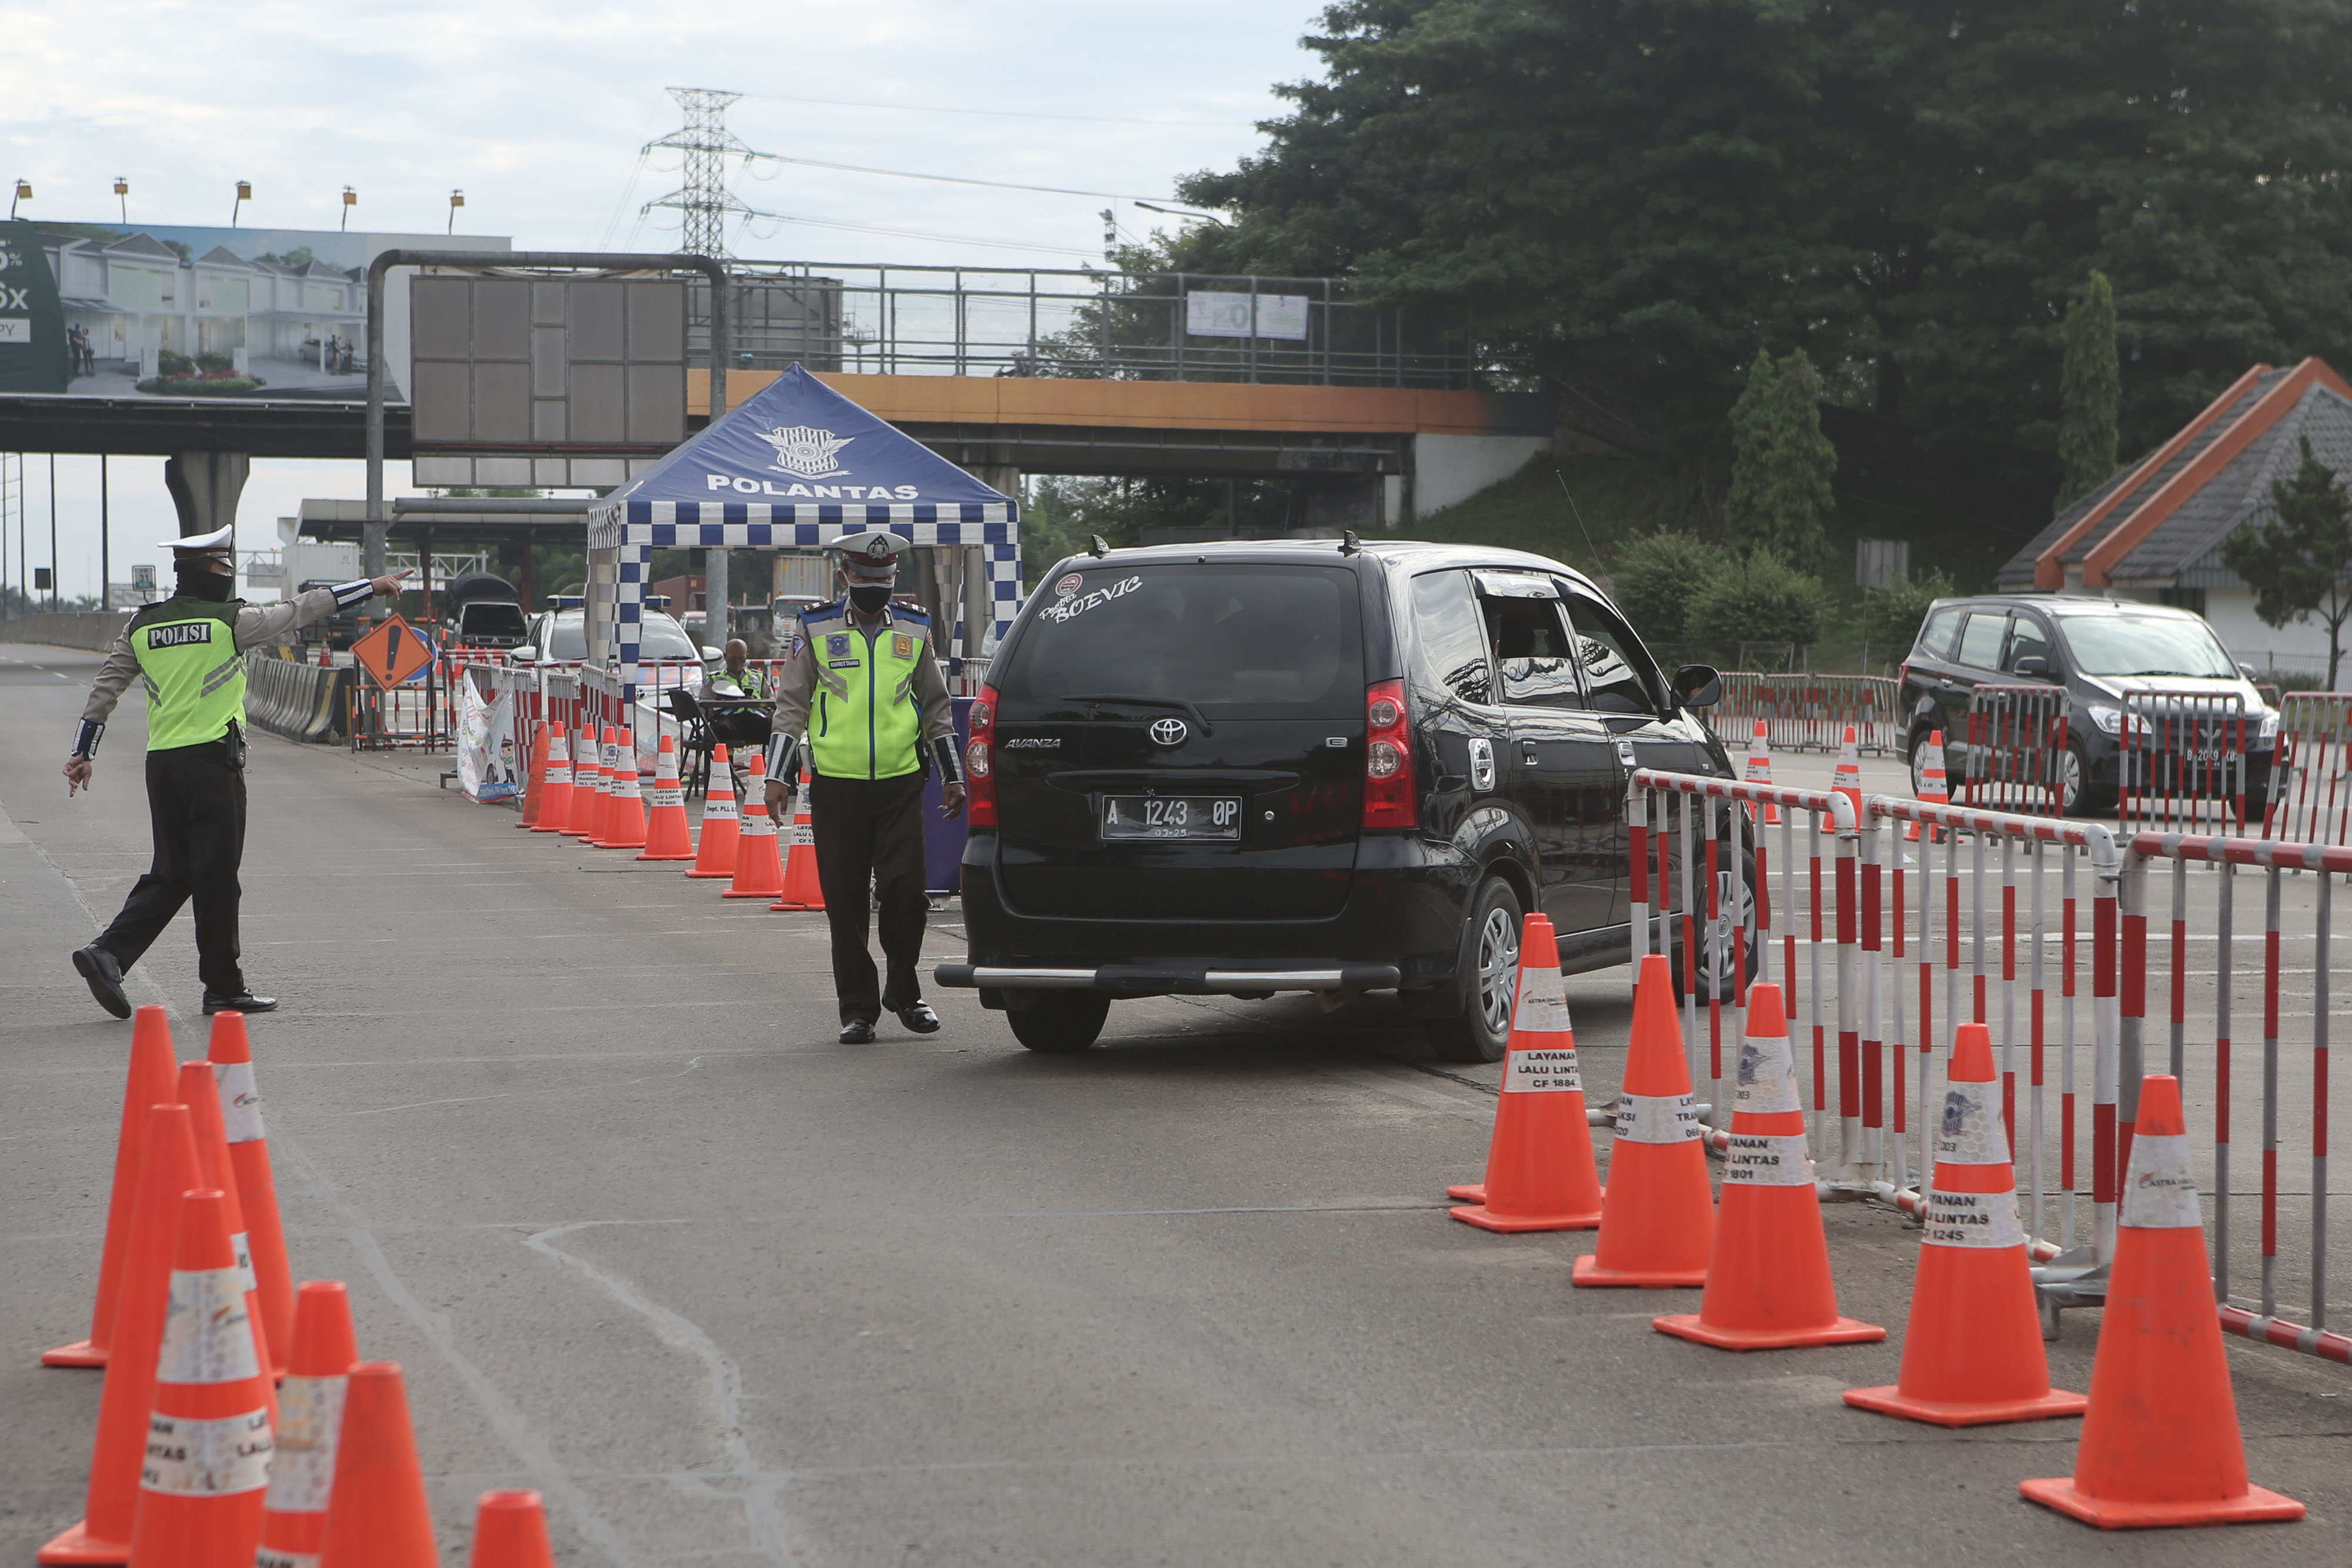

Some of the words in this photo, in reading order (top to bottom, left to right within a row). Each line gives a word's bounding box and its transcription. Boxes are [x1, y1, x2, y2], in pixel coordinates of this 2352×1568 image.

[707, 474, 918, 500] POLANTAS
[1050, 576, 1142, 624] BOEVIC
[150, 624, 208, 647] POLISI
[1004, 738, 1061, 748] AVANZA
[1107, 801, 1118, 825] A
[1144, 801, 1188, 825] 1243
[1518, 1066, 1549, 1074] LALU
[1553, 1079, 1575, 1087] 1884
[1732, 1155, 1780, 1165] LINTAS
[1936, 1214, 1989, 1225] LINTAS
[1933, 1230, 1965, 1241] 1245
